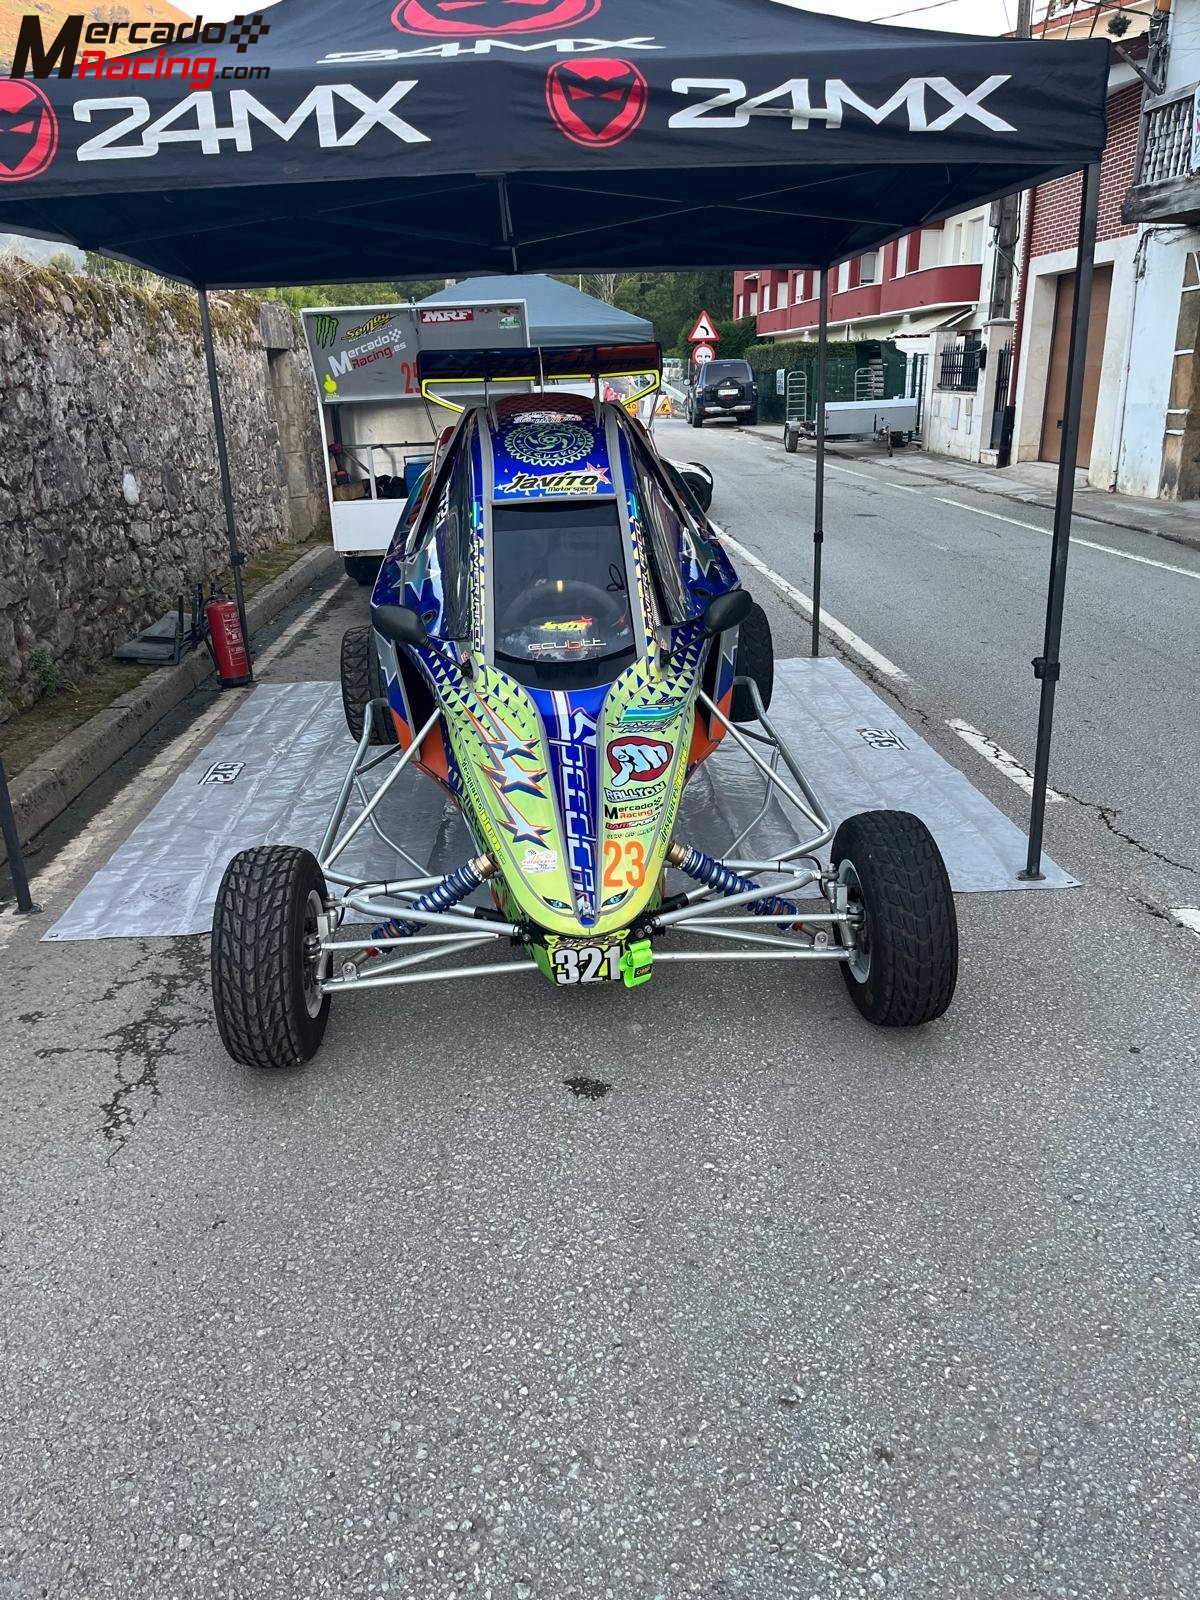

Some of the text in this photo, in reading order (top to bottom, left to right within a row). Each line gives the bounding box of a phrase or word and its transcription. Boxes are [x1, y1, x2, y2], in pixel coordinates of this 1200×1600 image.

[316, 37, 666, 63] 24MX
[668, 75, 1018, 132] 24MX
[73, 79, 431, 161] 24MX
[422, 309, 472, 323] MRF
[328, 334, 390, 377] Mercado
[547, 485, 595, 494] Motorsport
[604, 781, 667, 803] RALLYON
[604, 802, 653, 820] Mercado
[619, 808, 654, 819] Racing
[603, 840, 646, 888] 23
[554, 946, 621, 984] 321
